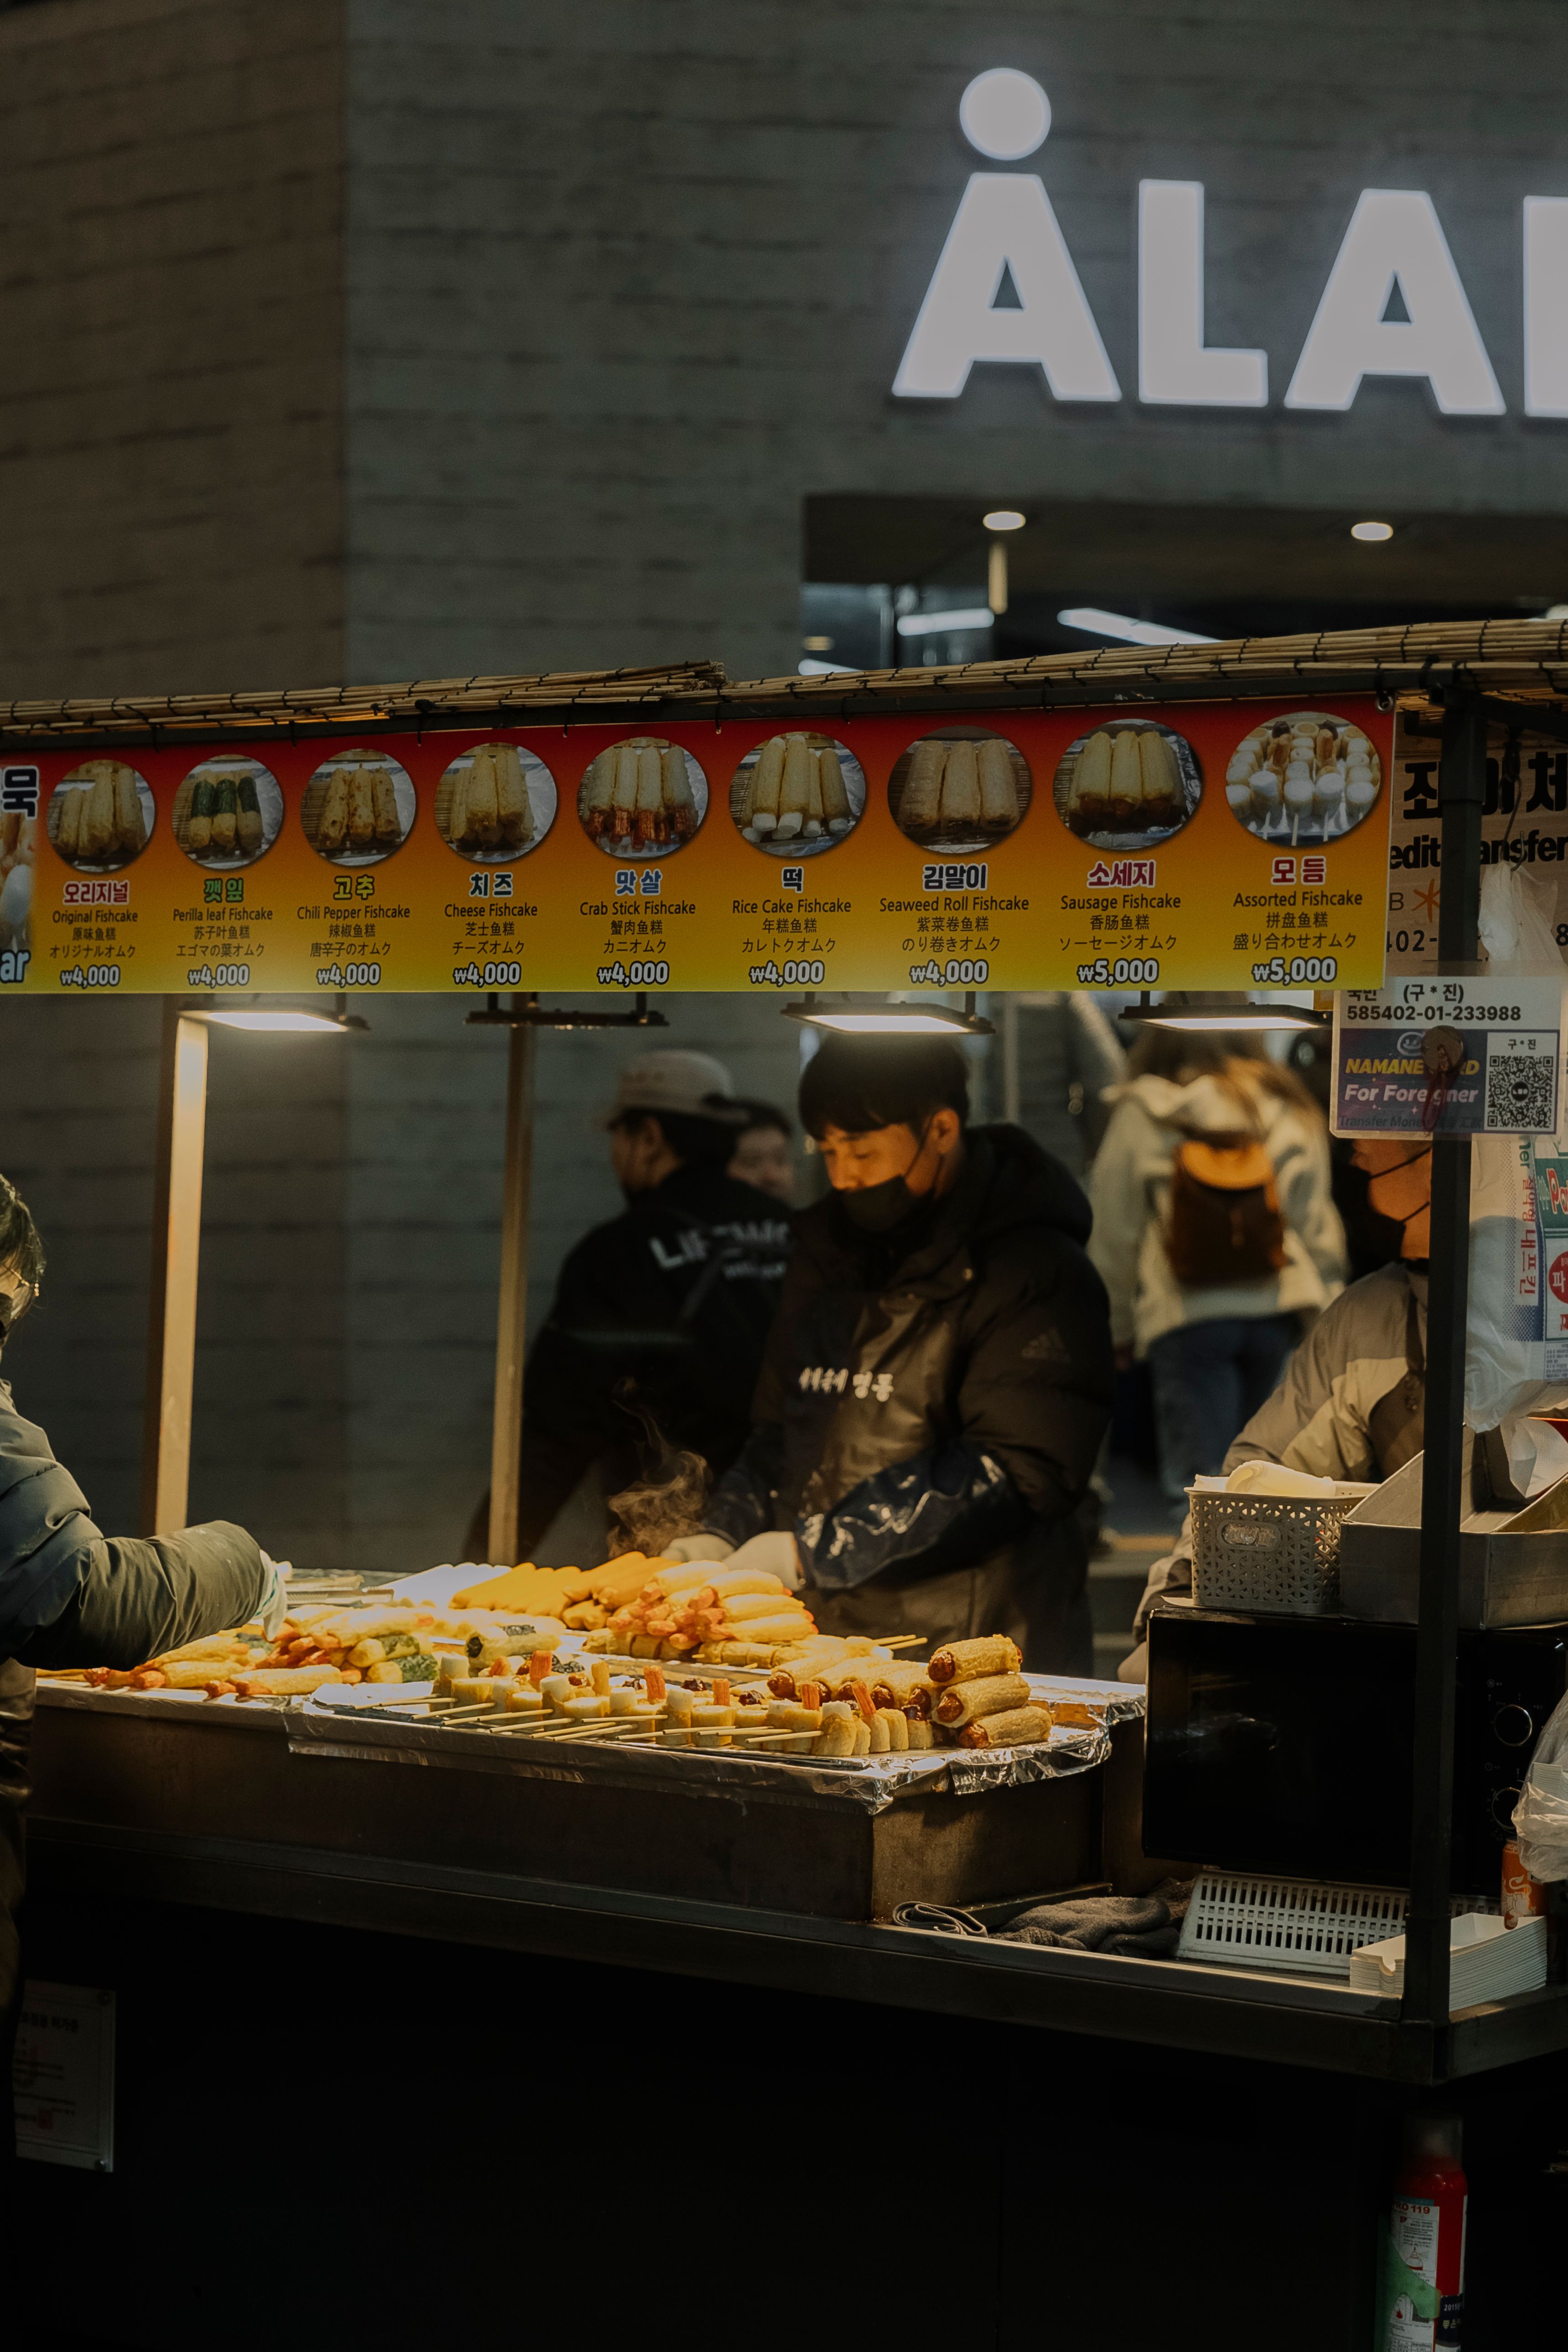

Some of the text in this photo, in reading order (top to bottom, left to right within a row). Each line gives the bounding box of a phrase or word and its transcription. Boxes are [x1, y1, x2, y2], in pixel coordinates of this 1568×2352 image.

[781, 866, 804, 893] 떡
[923, 863, 988, 891] 김말이
[1087, 859, 1156, 888] 소세지
[64, 882, 128, 903] 오리지널
[1233, 890, 1362, 907] Assorted Fishcake
[445, 902, 538, 917] Cheese Fishcake
[580, 900, 696, 916] Crab Stick Fishcake
[732, 898, 851, 913] Rice Cake Fishcake
[880, 896, 1029, 912] Seaweed Roll Fishcake
[1061, 893, 1181, 911] Sausage Fishcake
[52, 910, 138, 925] Original Fishcake
[173, 907, 273, 922] Perilla leaf Fishcake
[297, 905, 410, 921] Chili Pepper Fishcake
[1090, 913, 1149, 930] 香肠鱼糕
[1266, 912, 1328, 928] 拼盘鱼糕
[194, 925, 250, 940] 苏子叶鱼糕
[329, 923, 376, 938] 辣椒鱼糕
[465, 921, 515, 937] 芝士鱼糕
[611, 919, 663, 935] 蟹肉鱼糕
[762, 918, 817, 934] 年糕鱼糕
[917, 916, 989, 933] 紫菜卷鱼糕
[72, 927, 116, 941] 原味鱼糕
[60, 965, 120, 988] ₩4,000
[188, 964, 250, 989] ₩4,000
[316, 962, 381, 988] ₩4,000
[453, 961, 521, 987] ₩4,000
[596, 961, 670, 987] ₩4,000
[749, 959, 825, 987] ₩4,000
[909, 959, 989, 987] ₩4,000
[1076, 958, 1159, 987] ₩5,000
[1251, 956, 1337, 986] ₩5,000
[1347, 1005, 1521, 1021] 585402-01-233988
[1345, 1058, 1424, 1075] NAMANE
[1345, 1084, 1379, 1102] For
[1390, 1117, 1424, 1129] Mone
[1520, 1229, 1536, 1294] 내프킨
[1411, 2205, 1430, 2214] 119
